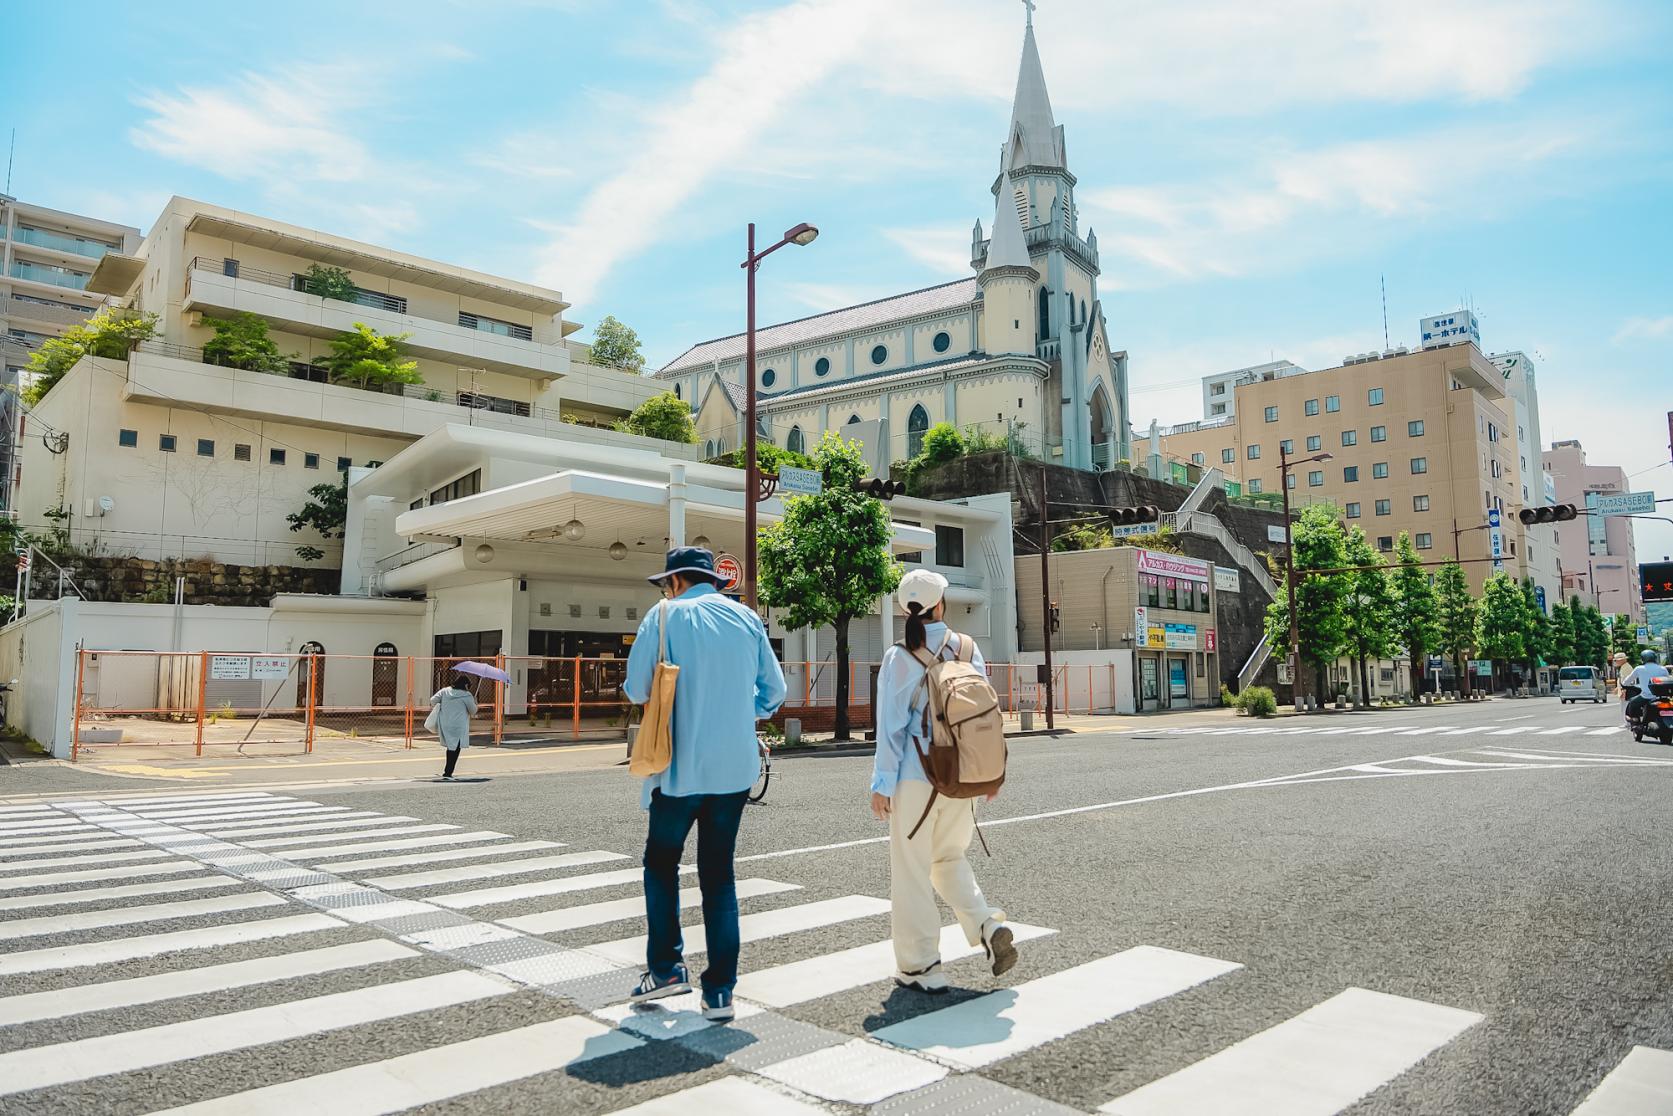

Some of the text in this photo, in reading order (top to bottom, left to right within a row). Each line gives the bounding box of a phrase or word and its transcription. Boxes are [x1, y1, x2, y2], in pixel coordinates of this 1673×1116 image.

[1423, 326, 1467, 340] 第一ホテル
